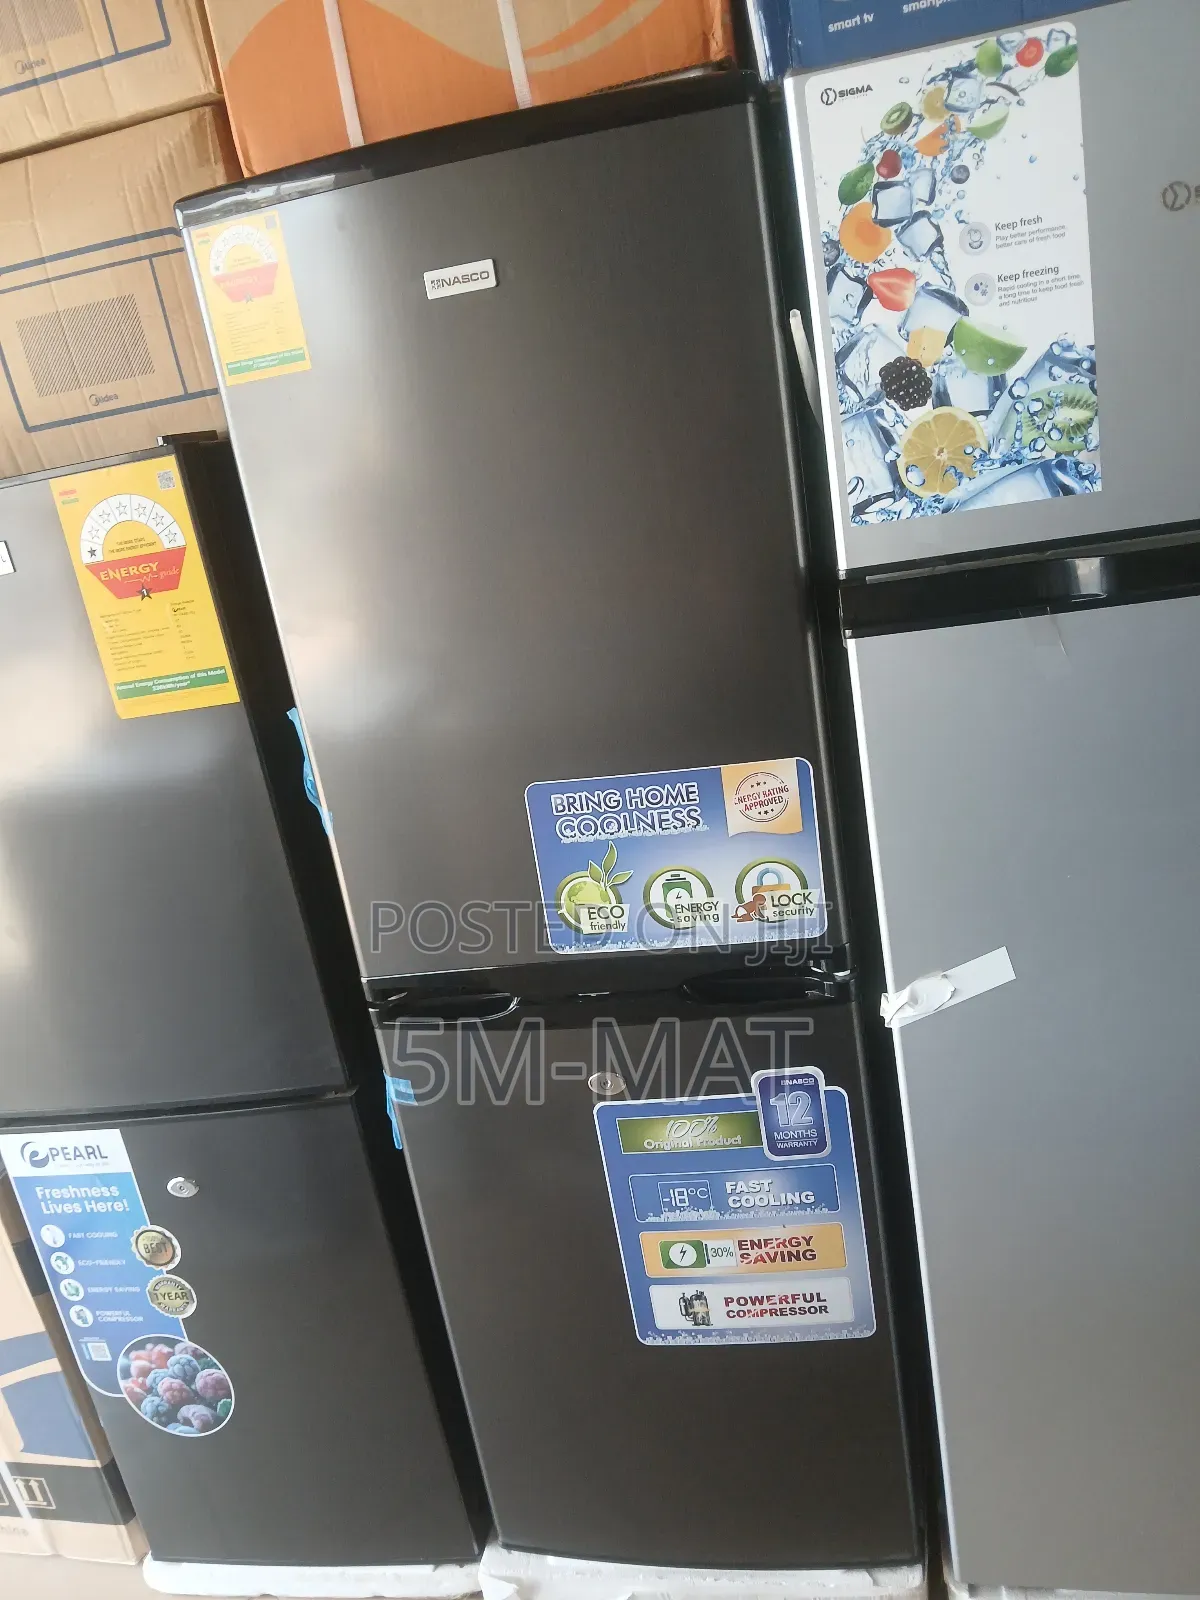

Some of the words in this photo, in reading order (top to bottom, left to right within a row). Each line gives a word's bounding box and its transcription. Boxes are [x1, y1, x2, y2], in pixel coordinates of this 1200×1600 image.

[828, 16, 861, 33] smart
[863, 12, 875, 23] tv
[838, 84, 873, 98] SIGMA
[995, 222, 1018, 231] Keep
[1020, 214, 1043, 226] fresh
[1052, 231, 1066, 239] food
[440, 270, 490, 288] NASCO
[997, 273, 1020, 282] Keep
[1022, 265, 1059, 279] freezing
[100, 562, 159, 581] ENERGY
[159, 566, 180, 579] guide
[142, 588, 148, 597] 1
[551, 787, 622, 815] BRING
[625, 782, 699, 809] HOME
[744, 795, 784, 812] APPROVED
[555, 807, 703, 841] COOLNESS
[675, 900, 719, 914] ENERGY
[770, 892, 813, 907] LOCK
[588, 905, 625, 921] ECO
[676, 912, 719, 923] saving
[772, 906, 815, 917] security
[590, 921, 626, 932] friendly
[770, 1091, 812, 1128] 12
[665, 1116, 720, 1138] 100%
[643, 1138, 693, 1150] Original
[697, 1135, 742, 1146] Product
[774, 1129, 818, 1141] MONTHS
[776, 1141, 818, 1149] WARRANTY
[48, 1145, 109, 1161] PEARL
[35, 1185, 120, 1200] Freshness
[725, 1180, 773, 1194] FAST
[40, 1201, 82, 1215] Lives
[84, 1199, 130, 1213] Here!
[728, 1191, 815, 1209] COOLING
[143, 1242, 168, 1254] BEST
[738, 1236, 814, 1251] ENERGY
[711, 1247, 734, 1258] 30%
[740, 1249, 817, 1265] SAVING
[160, 1291, 189, 1301] YEAR
[724, 1292, 827, 1307] POWERFUL
[726, 1305, 829, 1319] COMPRESSOR
